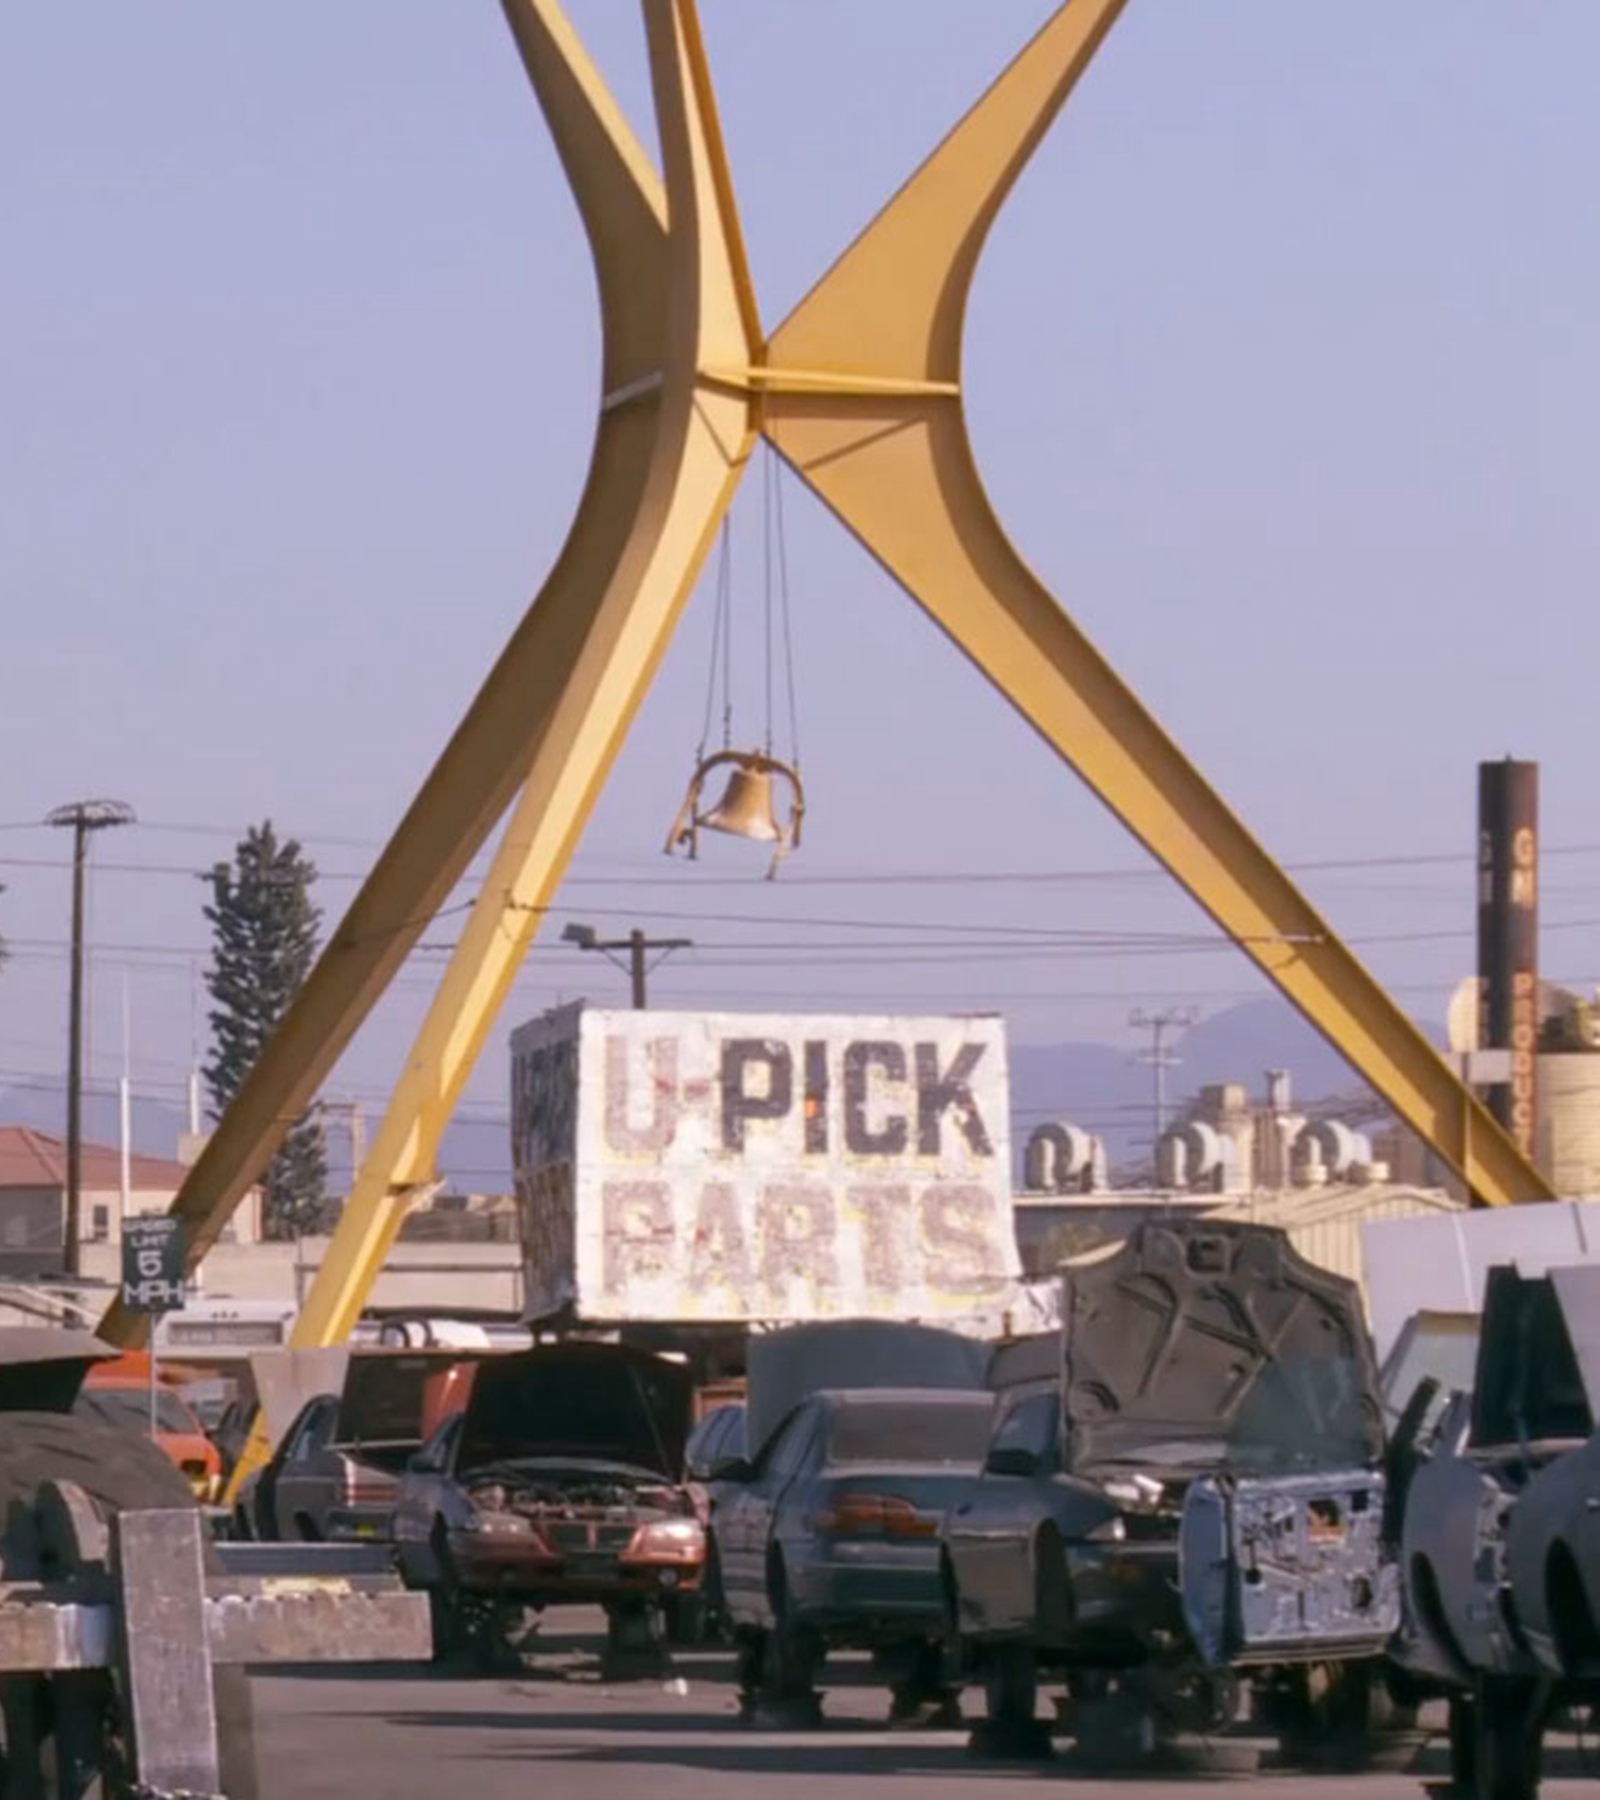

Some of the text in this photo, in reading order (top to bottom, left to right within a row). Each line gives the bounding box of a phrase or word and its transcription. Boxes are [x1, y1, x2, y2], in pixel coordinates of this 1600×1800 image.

[604, 1036, 995, 1156] U-PICK
[137, 1250, 162, 1277] 5
[602, 1181, 1006, 1297] PARTS
[123, 1279, 184, 1305] MPH
